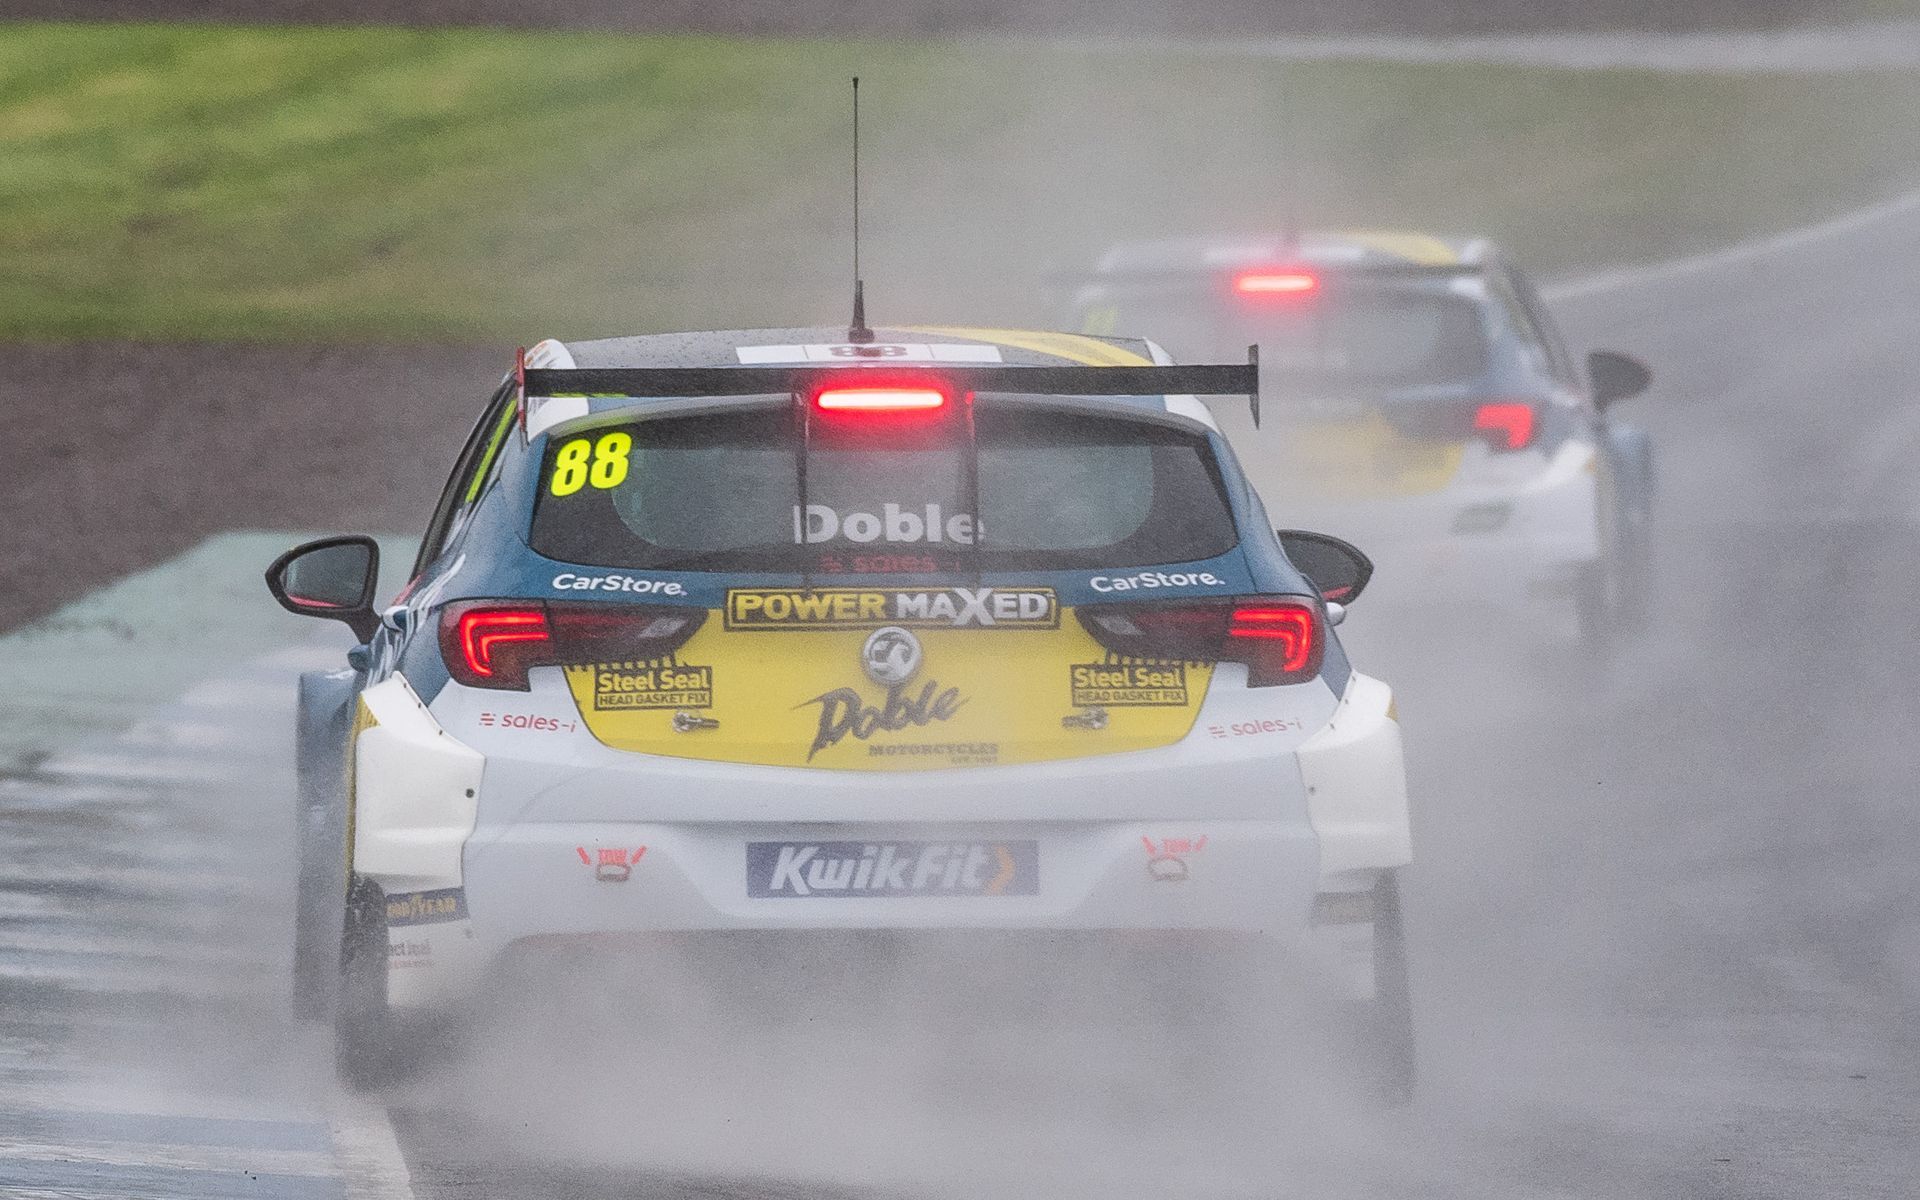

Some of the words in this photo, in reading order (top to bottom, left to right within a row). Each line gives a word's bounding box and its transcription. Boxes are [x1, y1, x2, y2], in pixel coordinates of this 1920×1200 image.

[551, 432, 632, 497] 88
[792, 503, 984, 544] Doble
[736, 593, 886, 620] POWER
[598, 670, 656, 693] Steel
[660, 668, 710, 690] Seal
[1074, 667, 1132, 688] Steel
[1135, 667, 1183, 688] Seal
[600, 694, 633, 705] HEAD
[636, 693, 685, 704] GASKET
[687, 692, 708, 703] FIX
[1077, 691, 1110, 701] HEAD
[1113, 691, 1160, 701] GASKET
[1162, 690, 1185, 701] FIX
[501, 714, 577, 733] sales-i
[791, 680, 972, 763] Doble
[1231, 717, 1302, 736] sales-i
[868, 743, 999, 757] MOTORCYCLES
